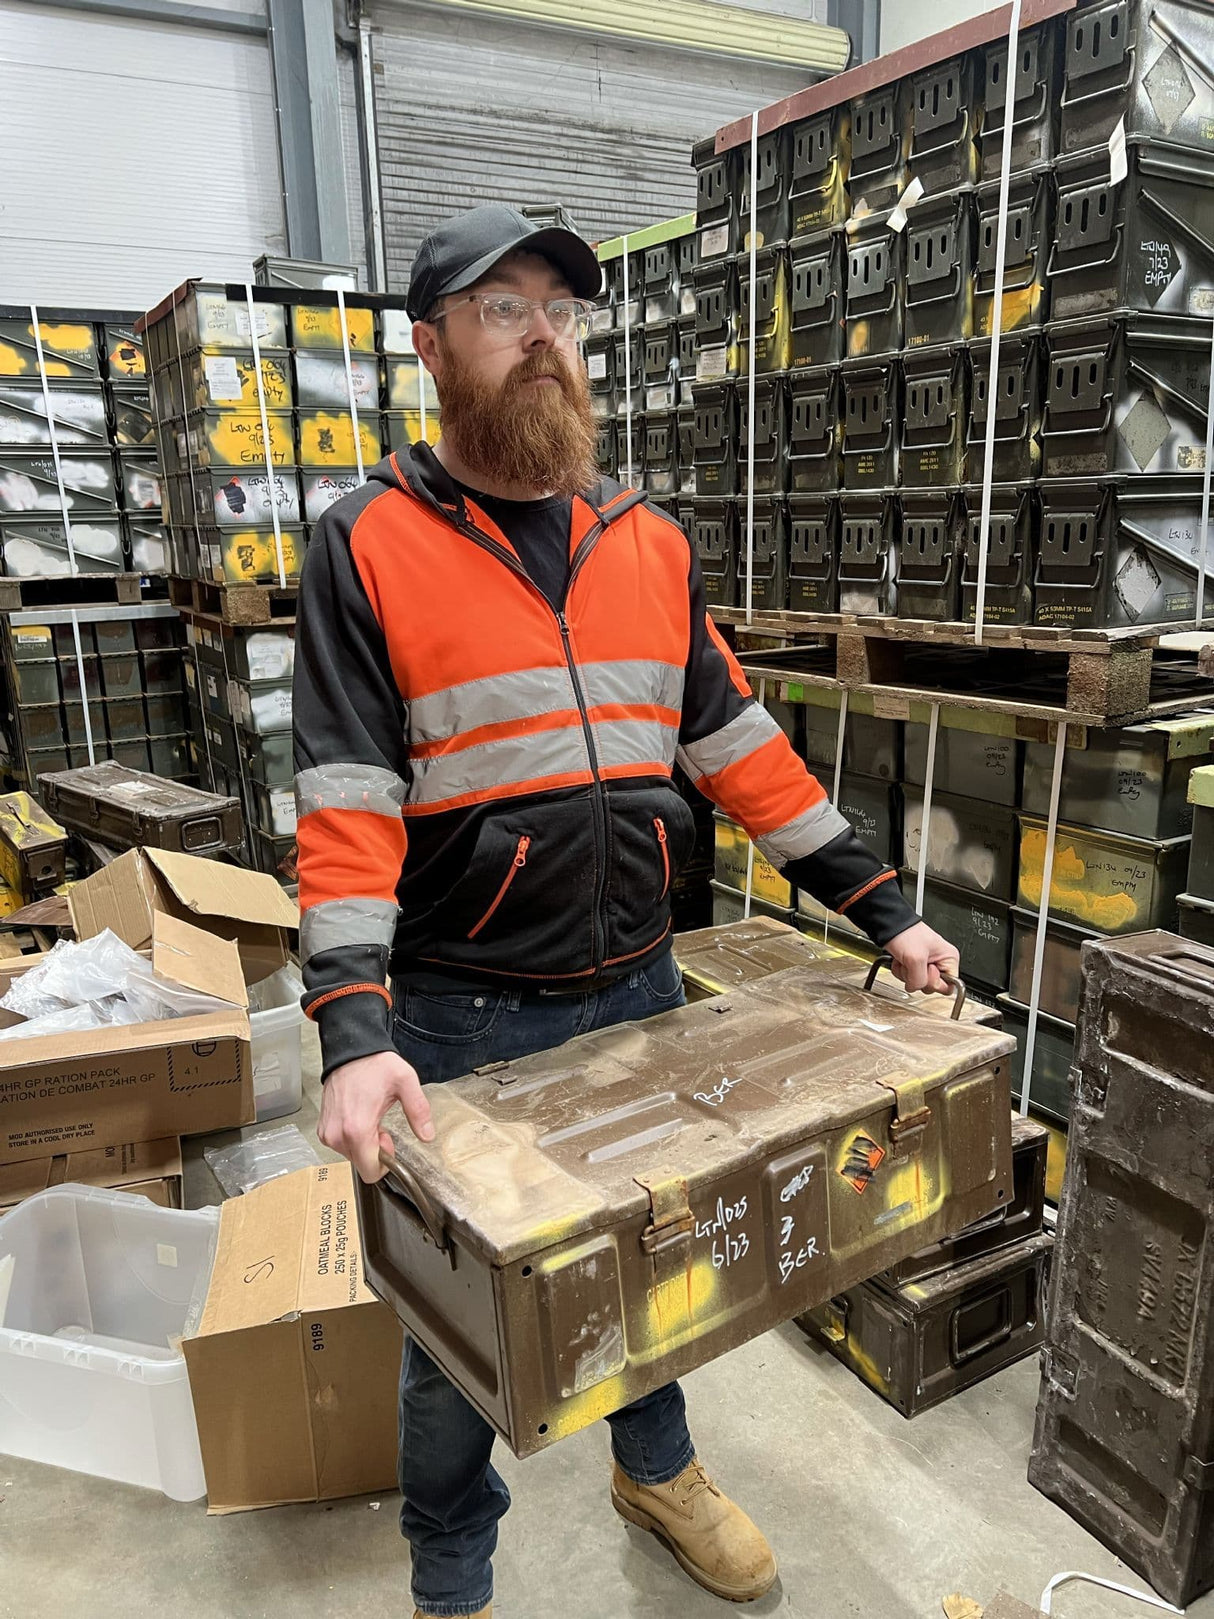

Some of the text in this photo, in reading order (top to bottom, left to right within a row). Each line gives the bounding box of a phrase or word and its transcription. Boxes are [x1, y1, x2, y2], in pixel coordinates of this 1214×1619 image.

[1149, 252, 1168, 271] 7/23
[24, 1078, 41, 1089] GP
[44, 1072, 87, 1086] RATION
[90, 1067, 121, 1078] PACK
[39, 1087, 55, 1098] DE
[58, 1080, 106, 1096] COMBAT
[109, 1076, 137, 1088] 24HR
[140, 1073, 156, 1083] GP
[8, 1122, 94, 1141] MOD AUTHORISED USE ONLY
[8, 1139, 29, 1149] STORE
[44, 1134, 62, 1143] COOL
[62, 1133, 75, 1141] DRY
[75, 1130, 96, 1138] PLACE
[318, 1167, 329, 1182] 9189
[318, 1204, 333, 1275] OATMEAL BLOCKS
[335, 1200, 348, 1275] 250 x 25g POUCHES
[712, 1233, 750, 1269] 6/23
[349, 1277, 357, 1302] PACKING
[311, 1323, 325, 1351] 9189
